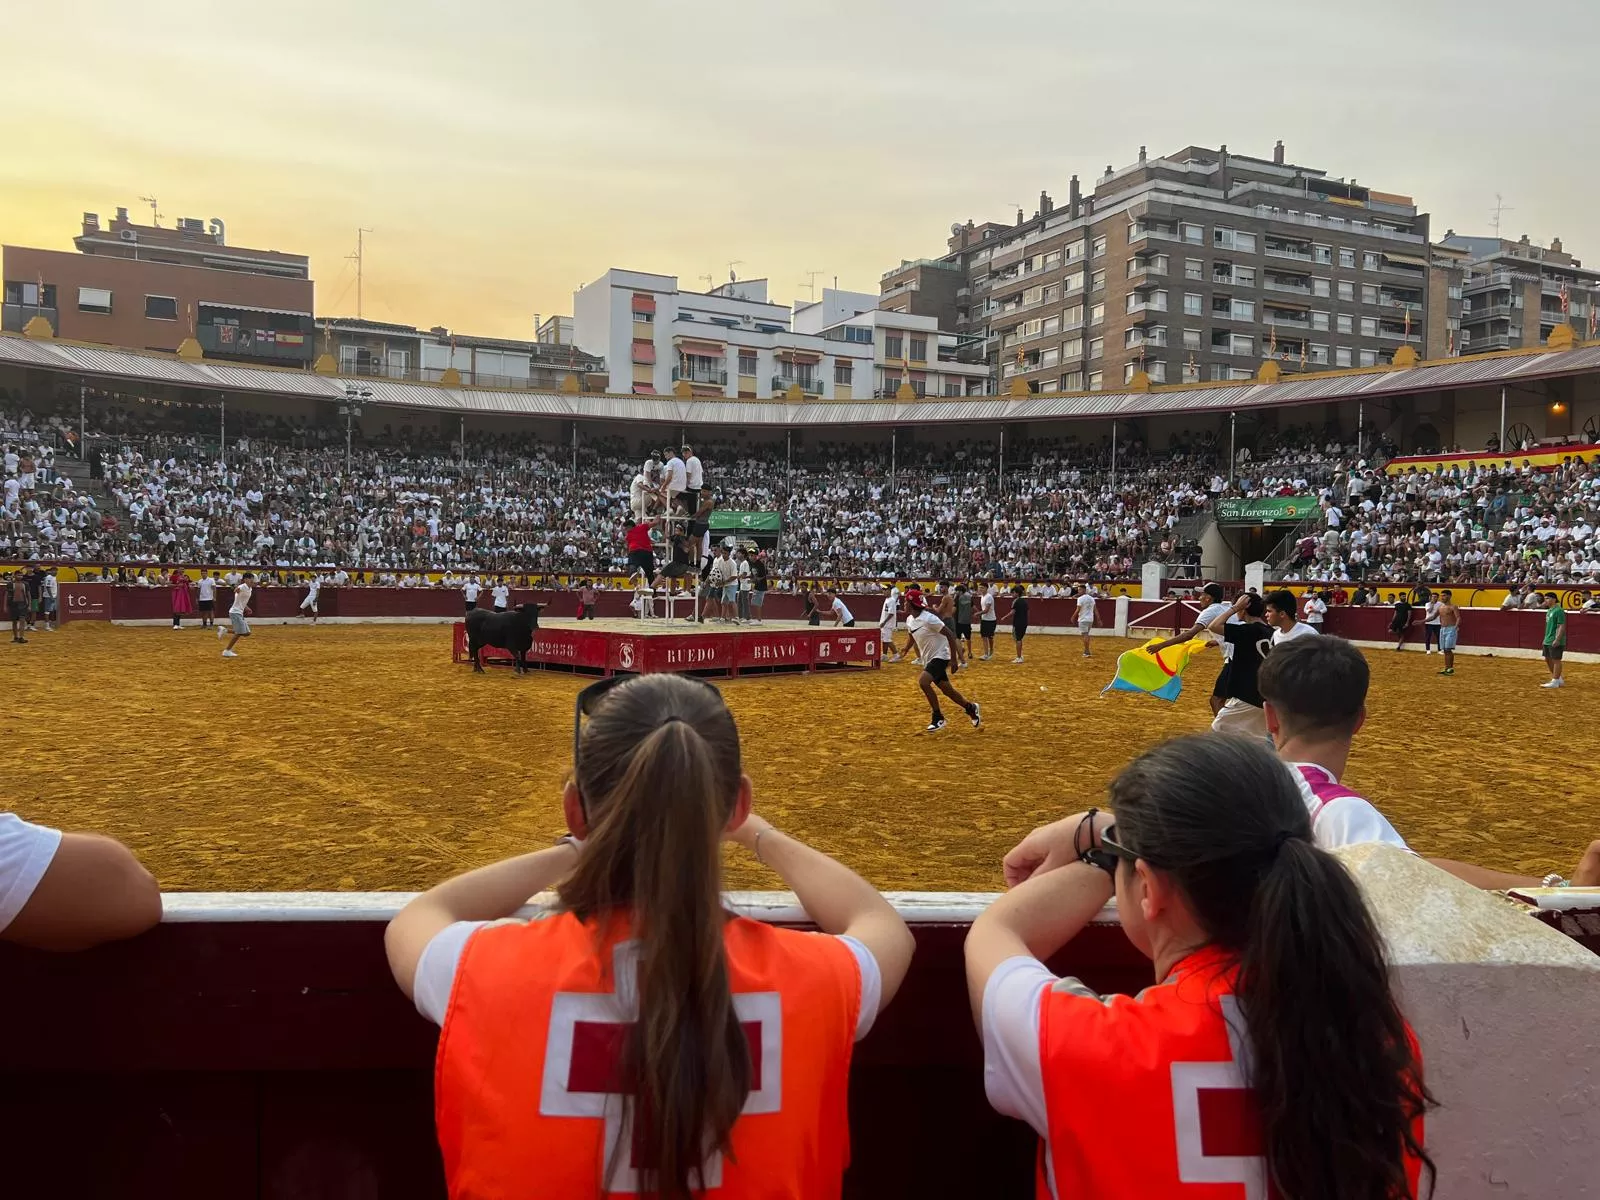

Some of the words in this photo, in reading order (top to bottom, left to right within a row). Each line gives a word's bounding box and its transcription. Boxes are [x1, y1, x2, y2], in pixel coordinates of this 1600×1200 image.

[1221, 509, 1239, 517] San
[1241, 507, 1283, 517] Lorenzo!
[1573, 593, 1581, 606] 6
[667, 647, 715, 663] RUEDO
[754, 643, 796, 659] BRAVO
